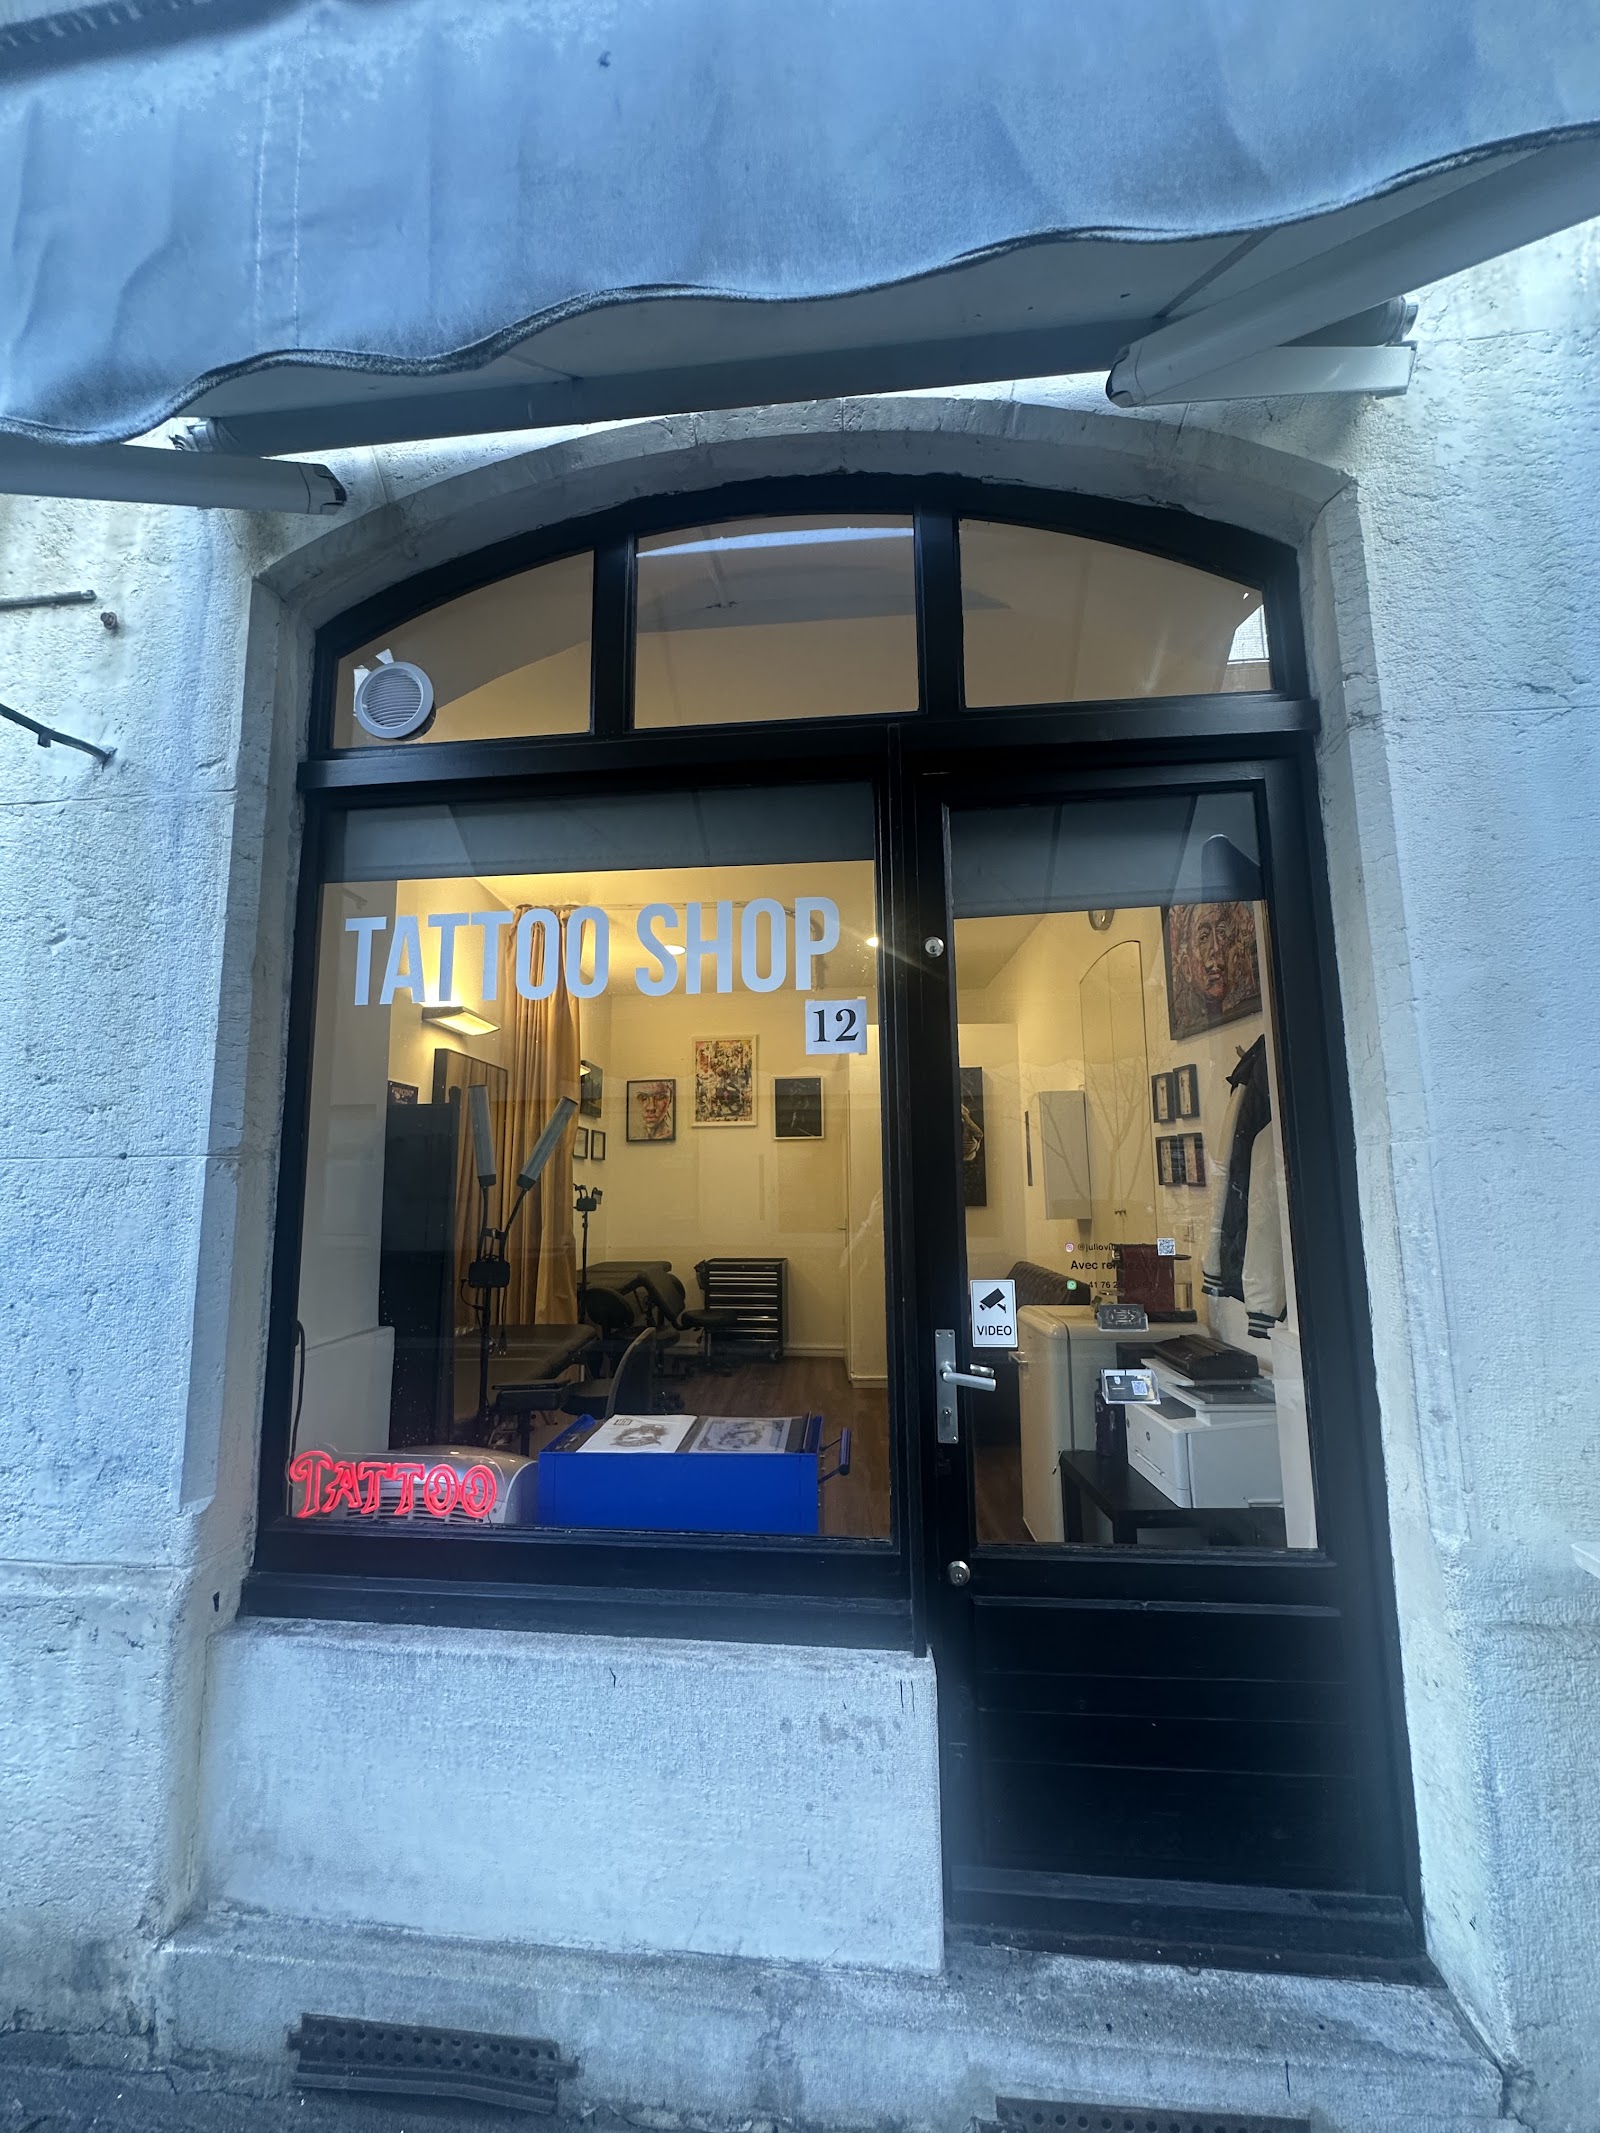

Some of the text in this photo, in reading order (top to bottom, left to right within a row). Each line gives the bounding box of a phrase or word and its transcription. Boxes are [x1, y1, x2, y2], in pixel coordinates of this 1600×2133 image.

[345, 897, 841, 1006] TATTOO SHOP
[812, 1007, 860, 1044] 12
[1070, 1260, 1099, 1270] Avec
[976, 1325, 1013, 1336] VIDEO
